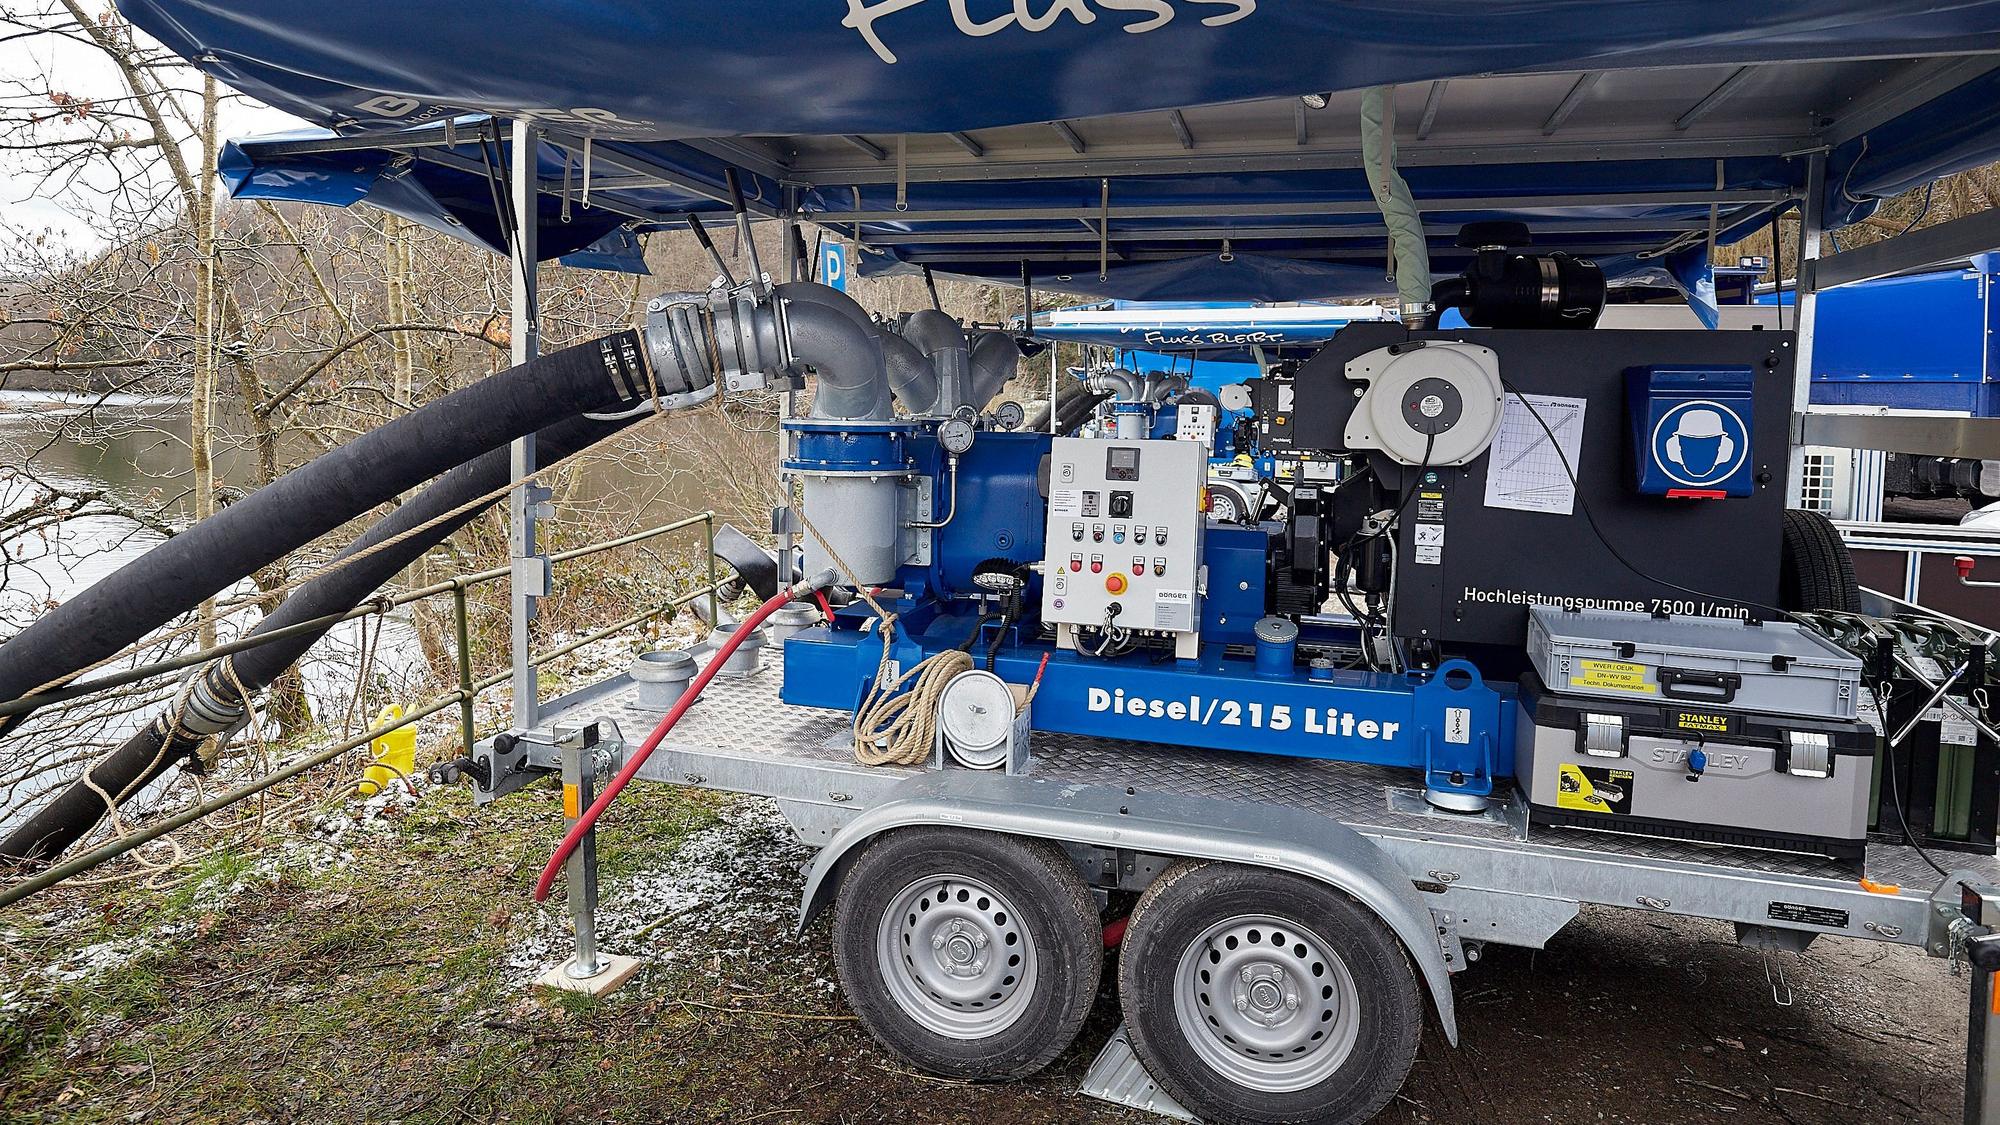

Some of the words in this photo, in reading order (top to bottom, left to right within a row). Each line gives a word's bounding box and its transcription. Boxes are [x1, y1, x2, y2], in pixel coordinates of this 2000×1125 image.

[826, 250, 841, 287] P
[1464, 587, 1645, 613] Hochleistungspumpe
[1651, 599, 1695, 616] 7500
[1700, 601, 1749, 620] l/min
[1088, 687, 1292, 731] Diesel/215
[1304, 708, 1399, 741] Liter
[1679, 713, 1728, 724] STANLEY
[1683, 722, 1721, 730] FATMAX
[1652, 747, 1749, 770] STALEY
